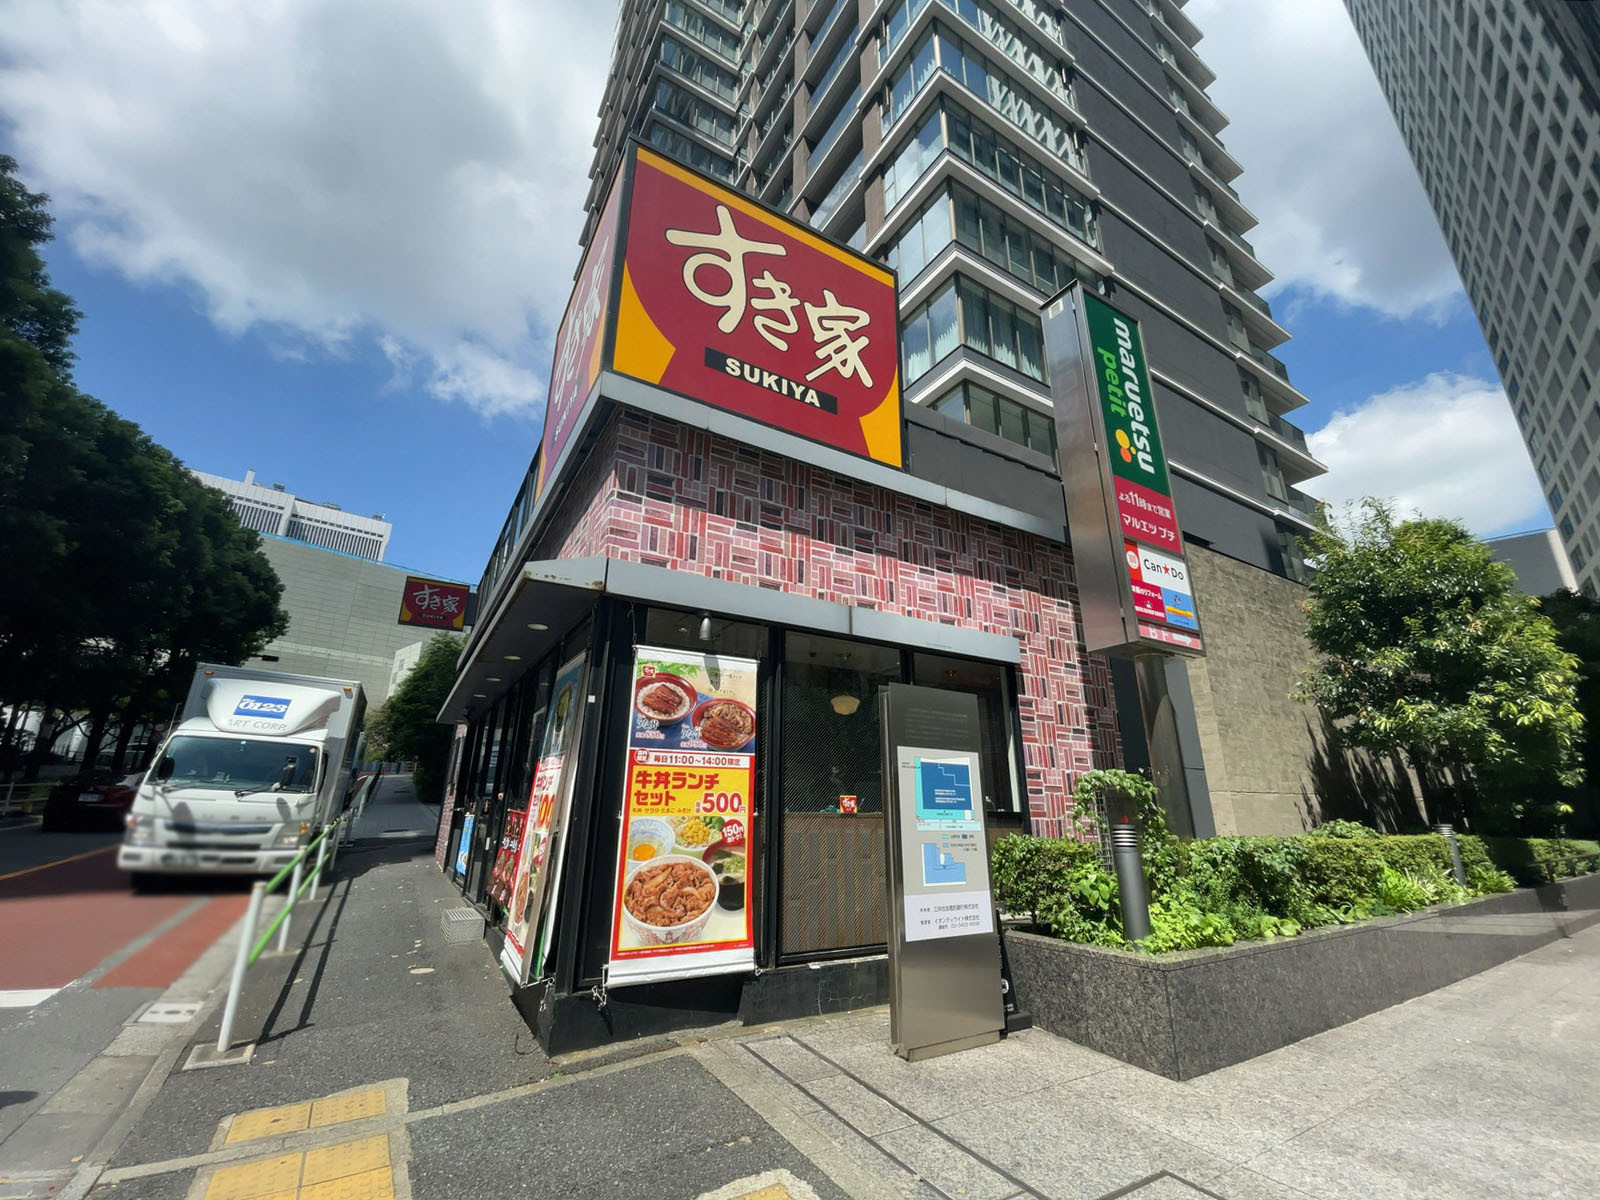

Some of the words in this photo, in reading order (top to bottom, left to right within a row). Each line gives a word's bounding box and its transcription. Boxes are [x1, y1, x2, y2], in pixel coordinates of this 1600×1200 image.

[664, 204, 874, 388] すき家
[553, 235, 610, 412] すき家
[724, 357, 822, 408] SUKIYA
[1097, 346, 1127, 417] petit
[1113, 317, 1156, 475] maruetsu
[412, 583, 461, 615] すき家
[239, 701, 288, 713] 0123
[634, 789, 677, 806] セット
[635, 770, 720, 790] 牛丼ランチ
